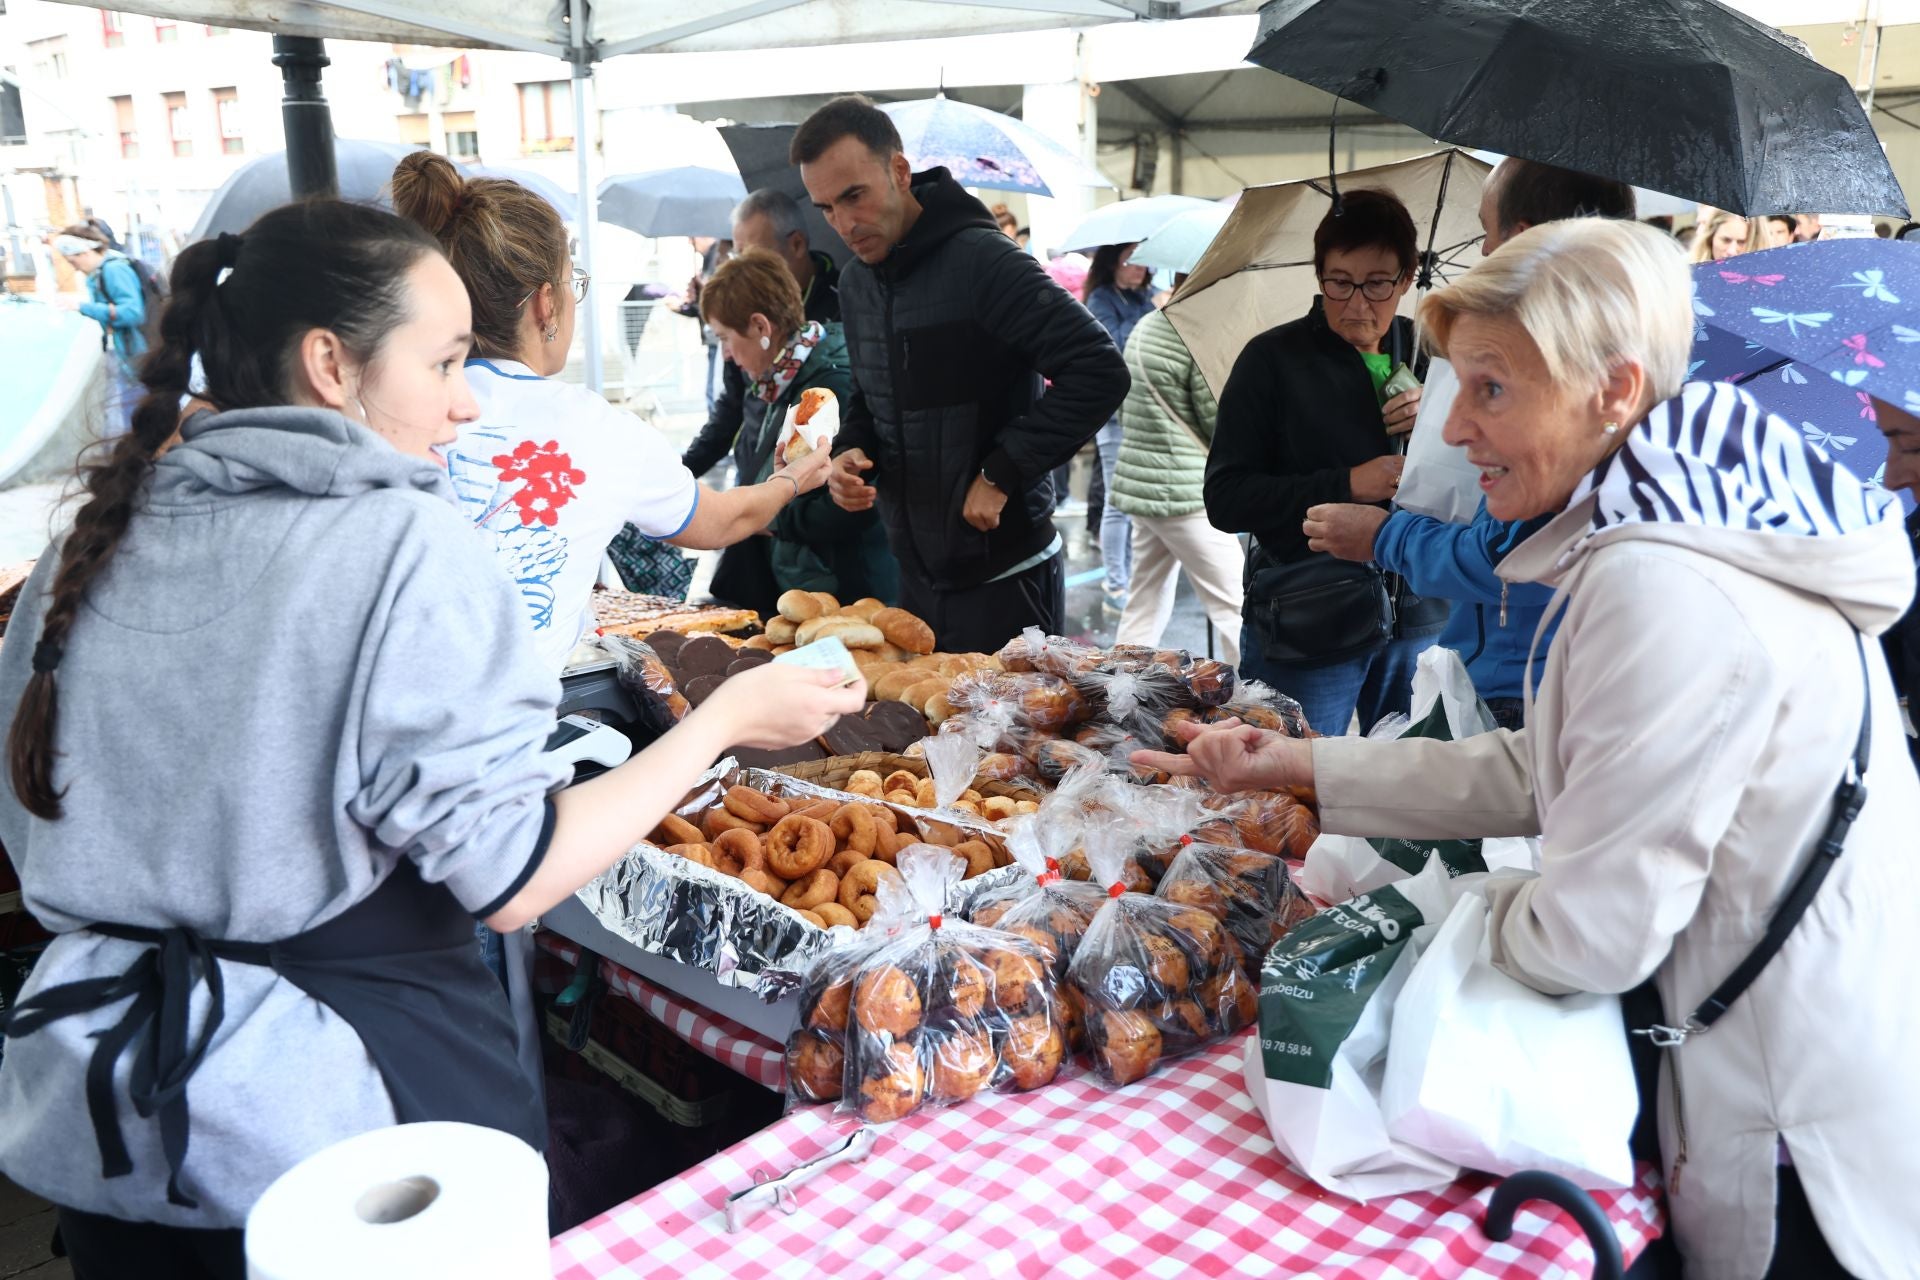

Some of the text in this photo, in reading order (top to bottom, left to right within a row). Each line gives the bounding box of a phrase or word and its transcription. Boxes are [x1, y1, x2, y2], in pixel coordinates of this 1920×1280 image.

[1323, 907, 1376, 939] TEGIA
[1273, 1040, 1286, 1052] 78
[1286, 1043, 1299, 1055] 58
[1300, 1045, 1312, 1057] 84
